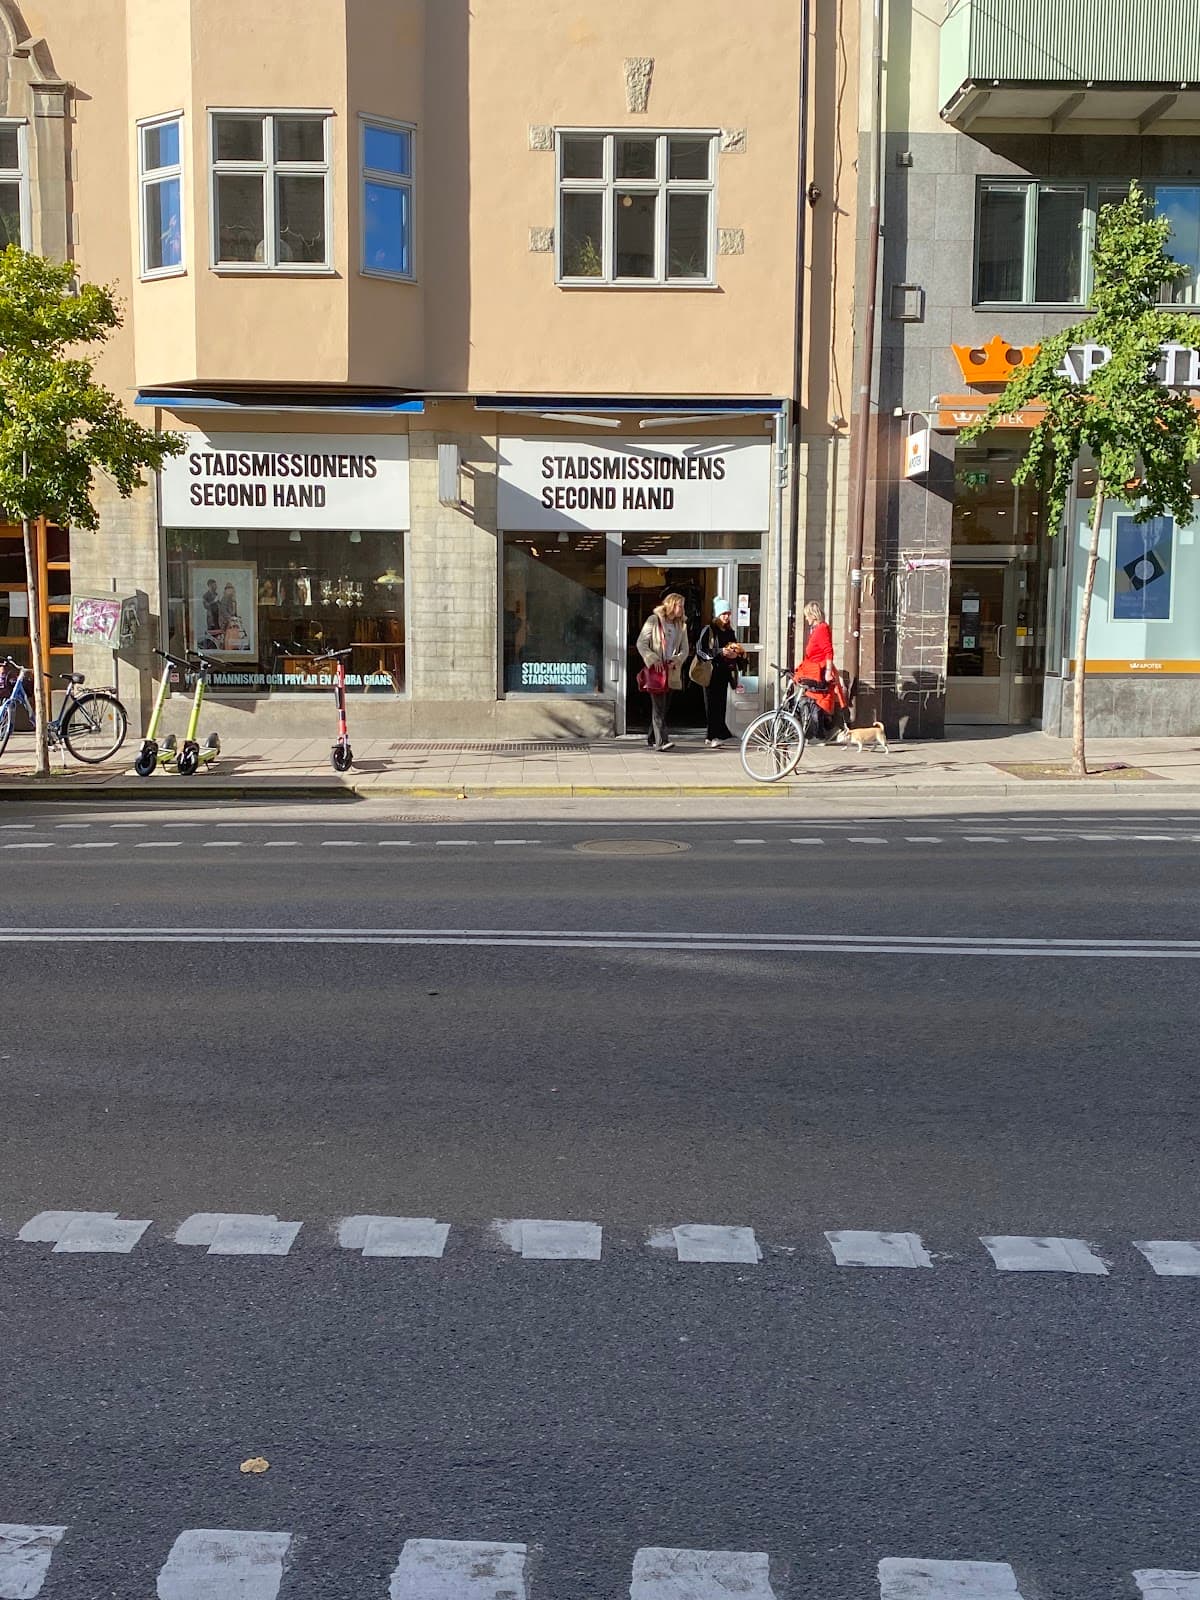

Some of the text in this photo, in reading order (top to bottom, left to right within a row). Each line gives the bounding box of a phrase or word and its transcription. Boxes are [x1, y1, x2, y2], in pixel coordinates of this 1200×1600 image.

[189, 453, 377, 478] STADSMISSIONENS
[541, 456, 726, 480] STADSMISSIONENS
[190, 483, 326, 507] SECOND HAND
[541, 487, 675, 510] SECOND HAND
[266, 673, 283, 685] OCH
[284, 674, 318, 685] PRYLAR
[319, 674, 332, 686] EN
[333, 674, 362, 686] ADRA
[363, 674, 393, 686] CHANS
[521, 662, 587, 674] STOCKHOLMS
[521, 674, 587, 685] STADSMISSION
